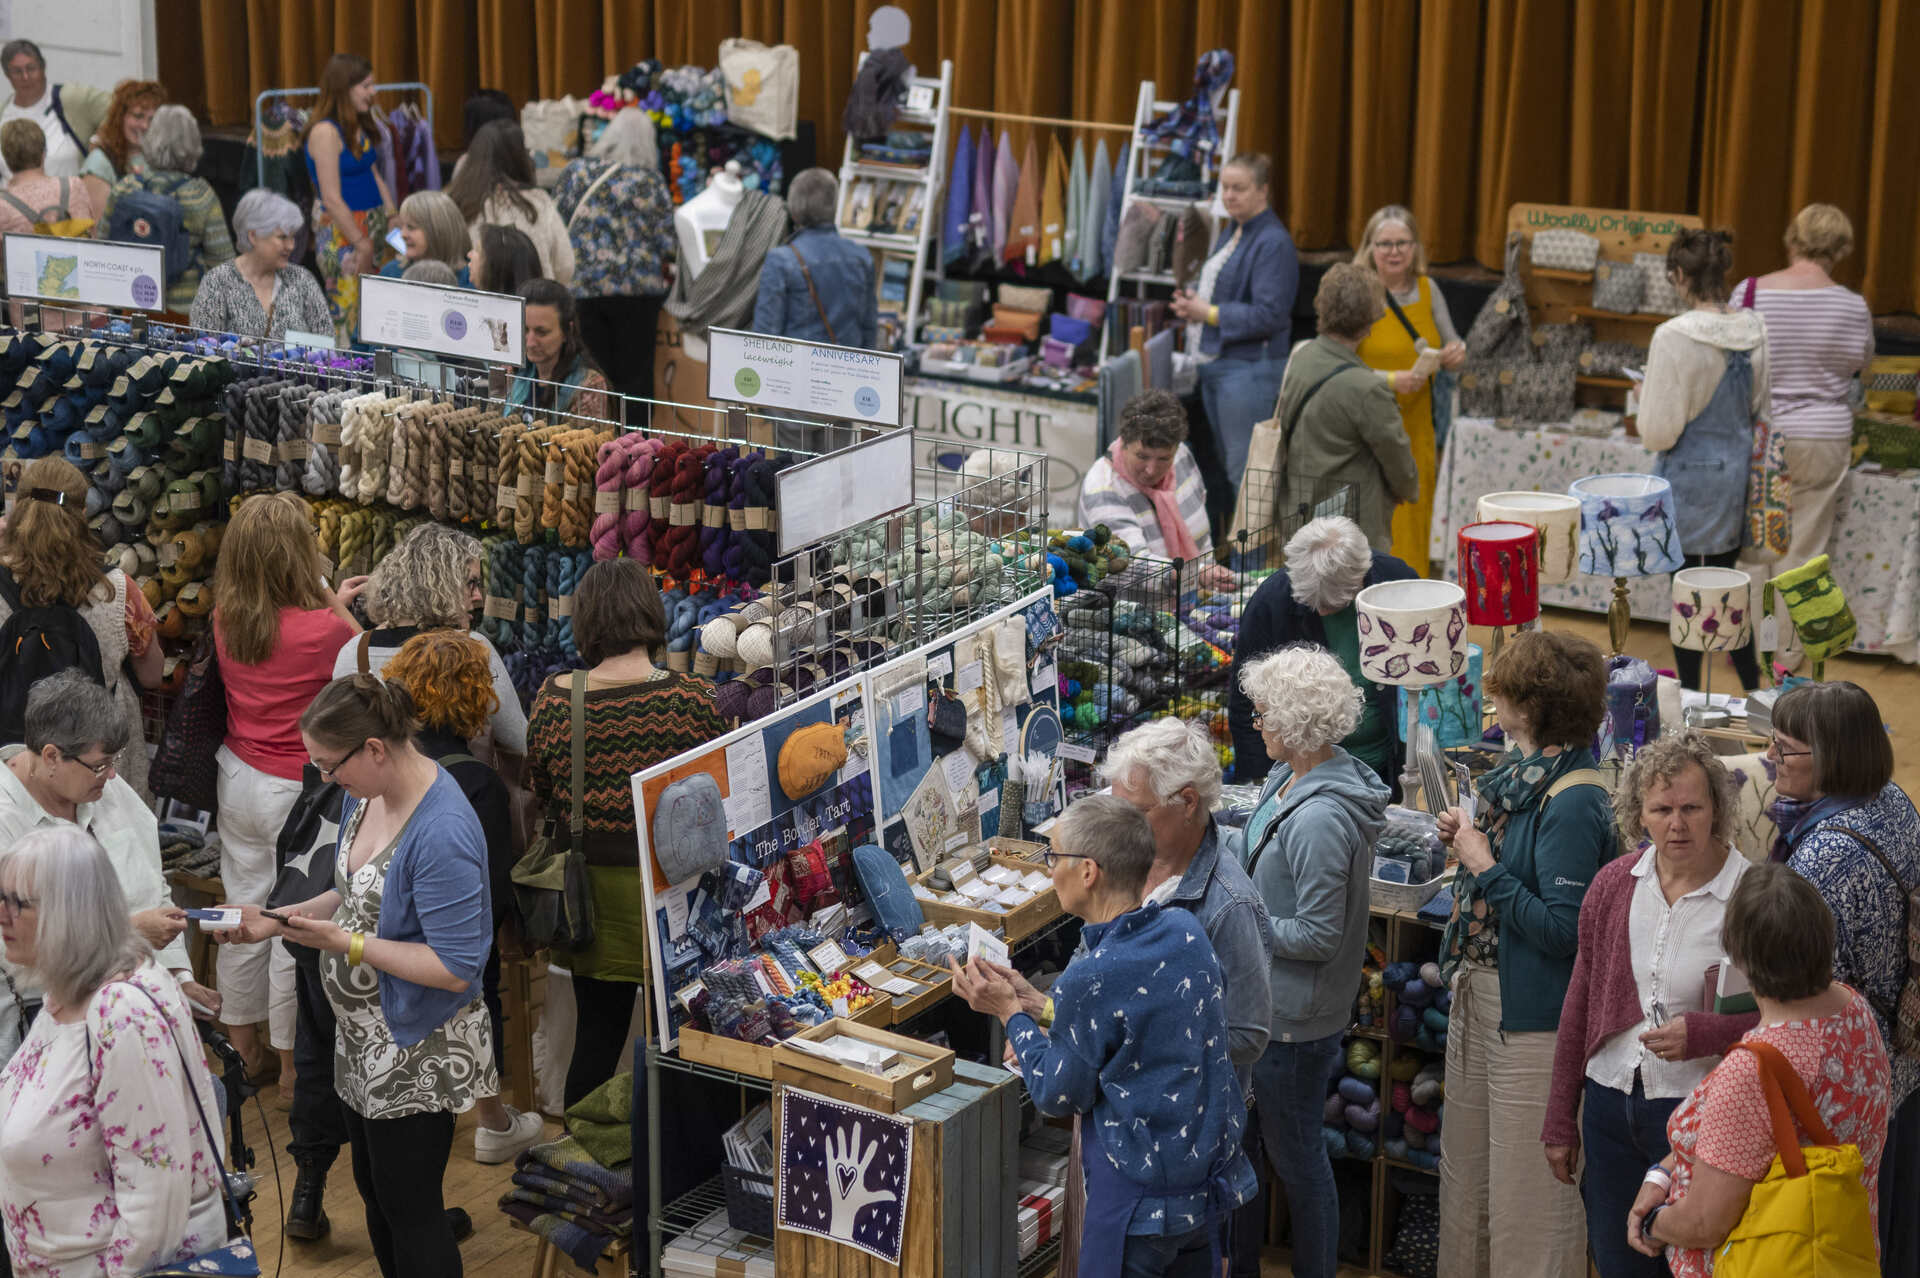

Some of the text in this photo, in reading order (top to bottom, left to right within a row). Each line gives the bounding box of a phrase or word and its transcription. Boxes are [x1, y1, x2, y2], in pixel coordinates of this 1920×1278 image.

[1527, 210, 1598, 233] Woolly
[743, 336, 793, 353] SHETLAND
[743, 351, 794, 368] laceweight
[811, 347, 881, 366] ANNIVERSARY
[755, 798, 851, 860] The Boder Tart
